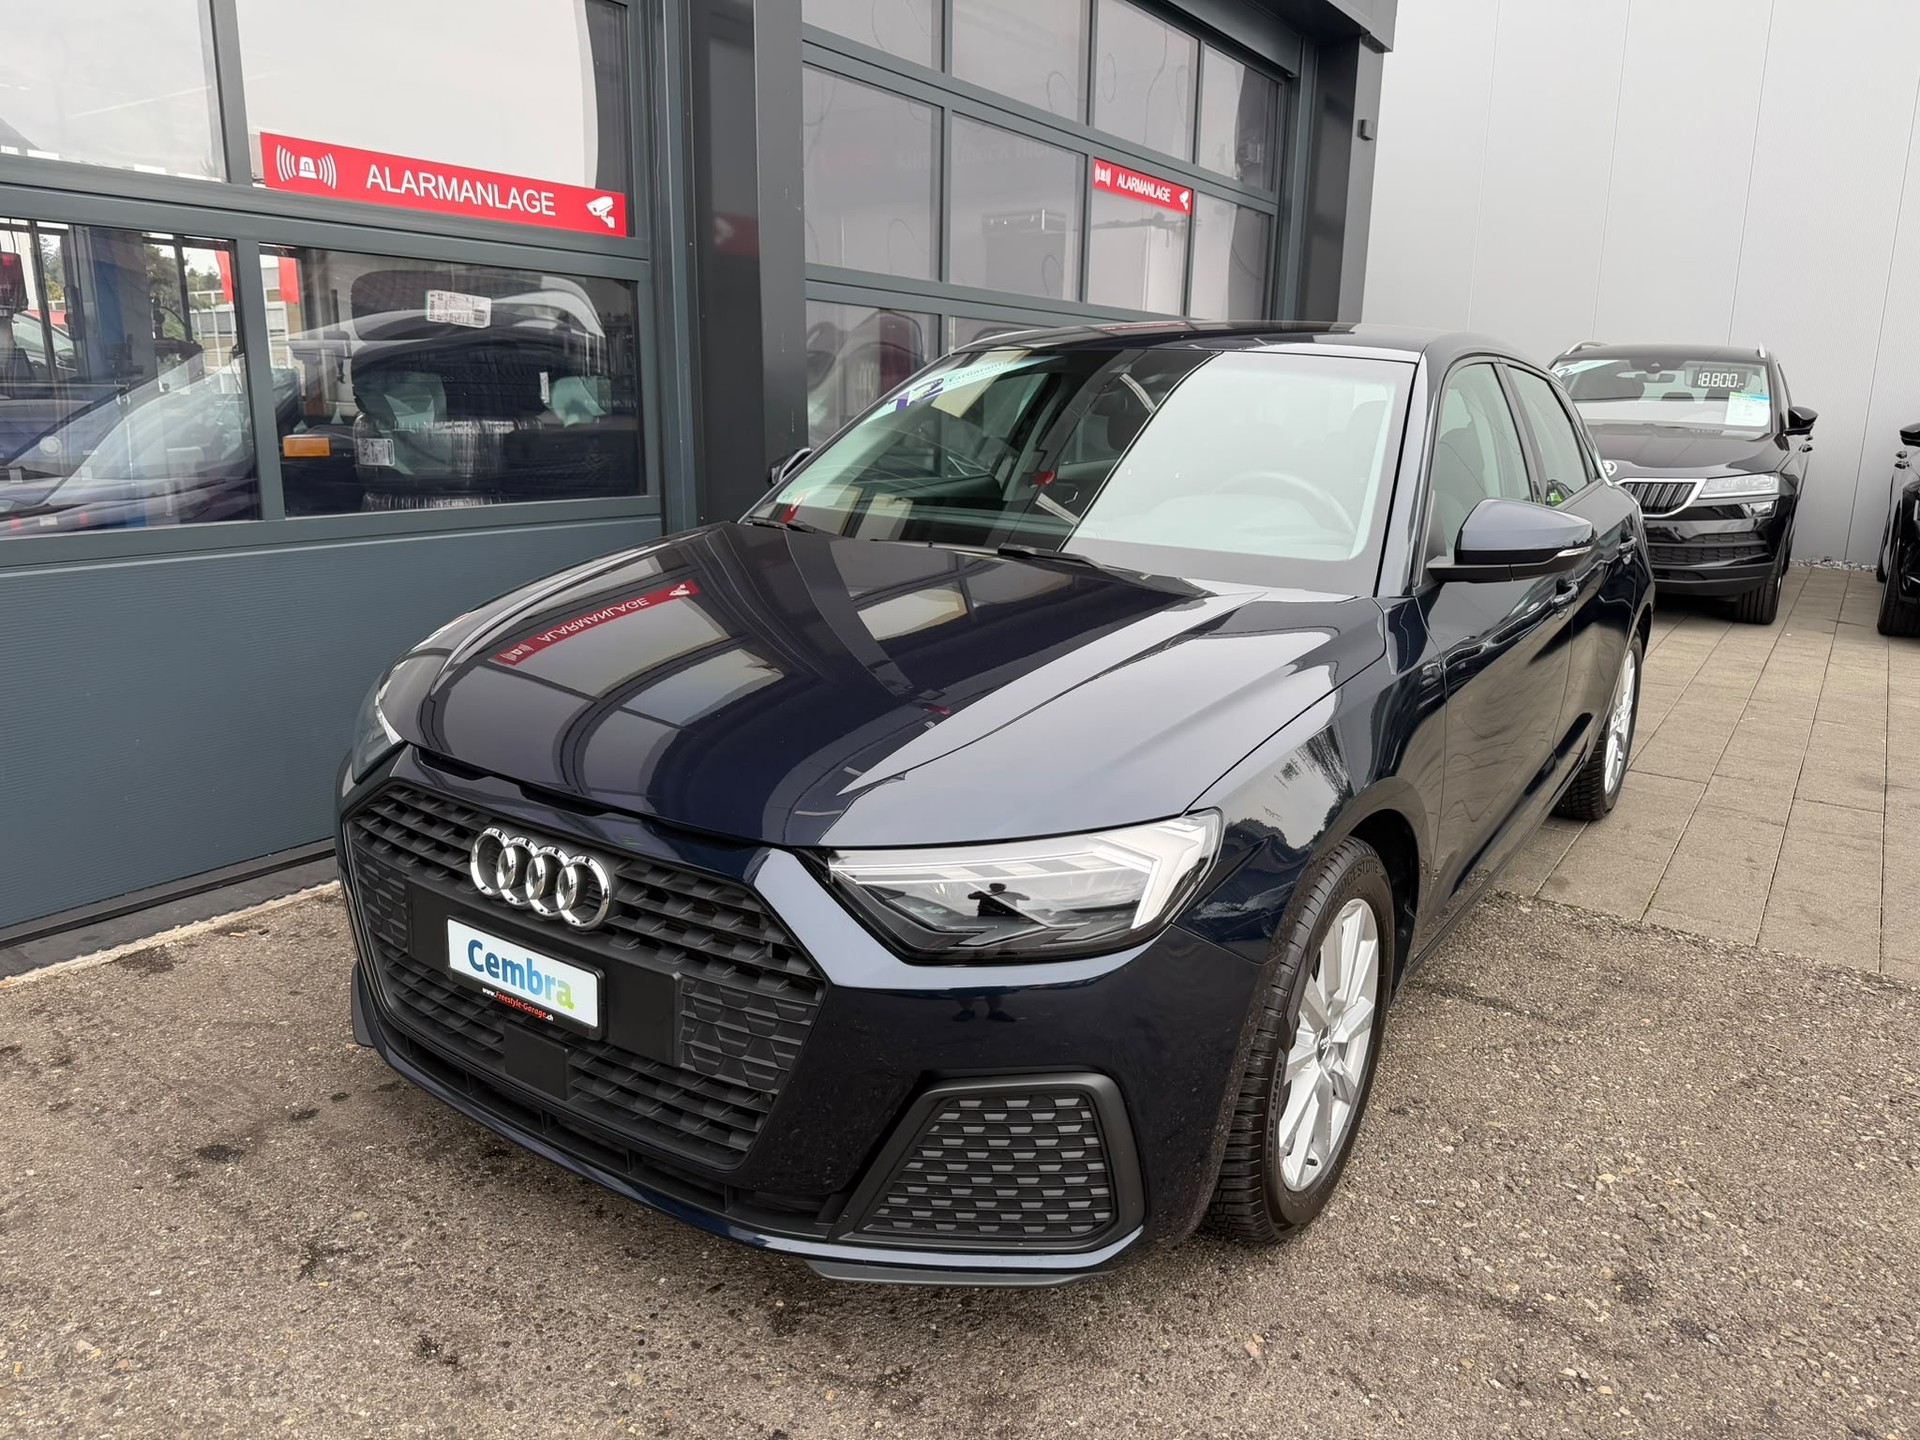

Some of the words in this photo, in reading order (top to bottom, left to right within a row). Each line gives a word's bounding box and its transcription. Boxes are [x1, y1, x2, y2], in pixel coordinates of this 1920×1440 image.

[366, 164, 556, 216] ALARMANLAGE
[1116, 172, 1171, 203] ALARMANLAGE
[468, 939, 574, 1010] Cembra
[482, 987, 554, 1021] www.Freestyle-Garage.ch
